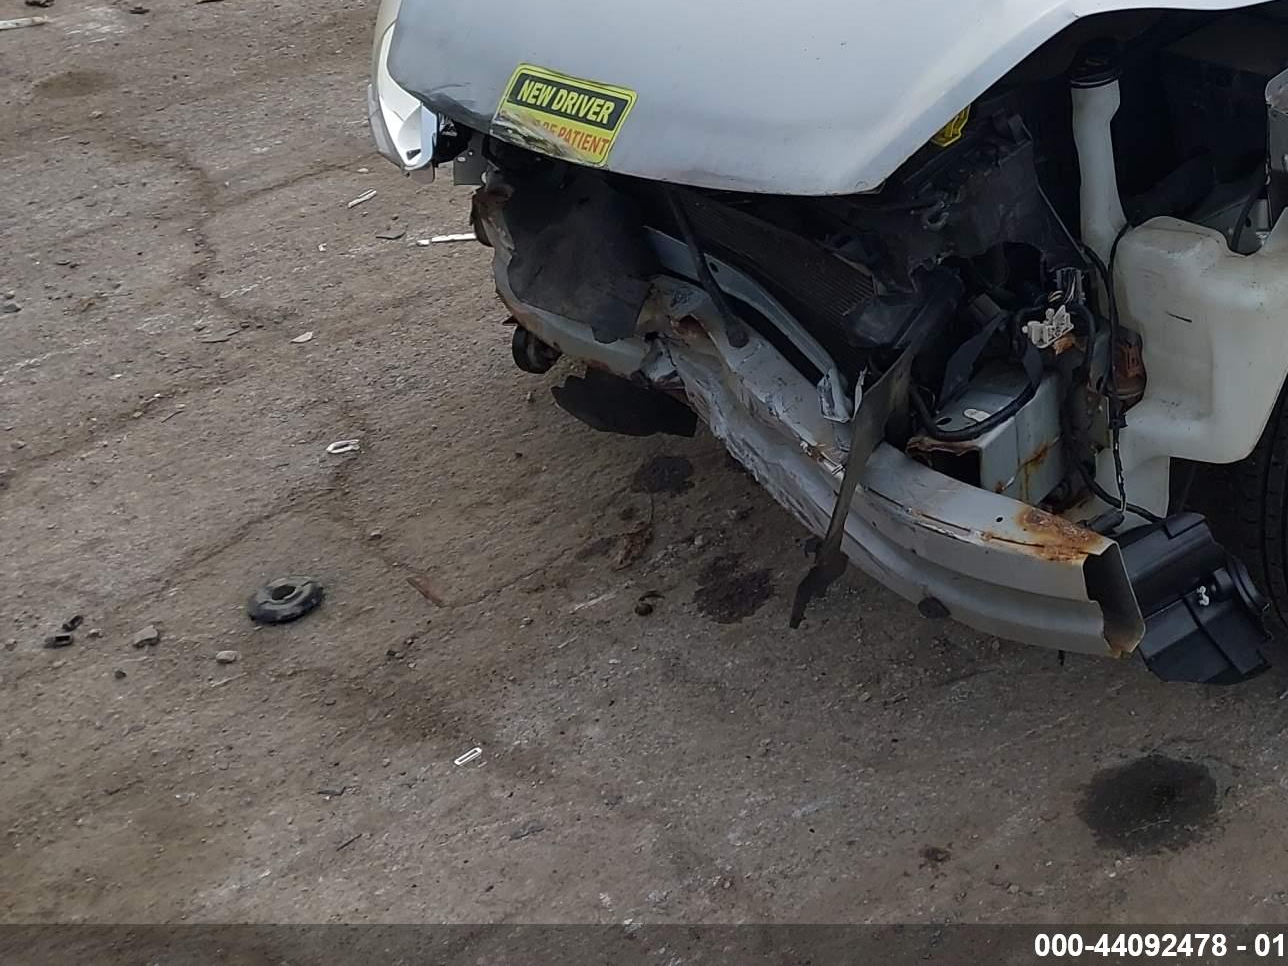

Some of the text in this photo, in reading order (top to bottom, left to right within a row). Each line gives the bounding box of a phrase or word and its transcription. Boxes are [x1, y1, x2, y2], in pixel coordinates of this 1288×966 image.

[517, 79, 557, 108] NEW
[551, 88, 616, 125] DRIVER
[557, 125, 610, 156] PATIENT
